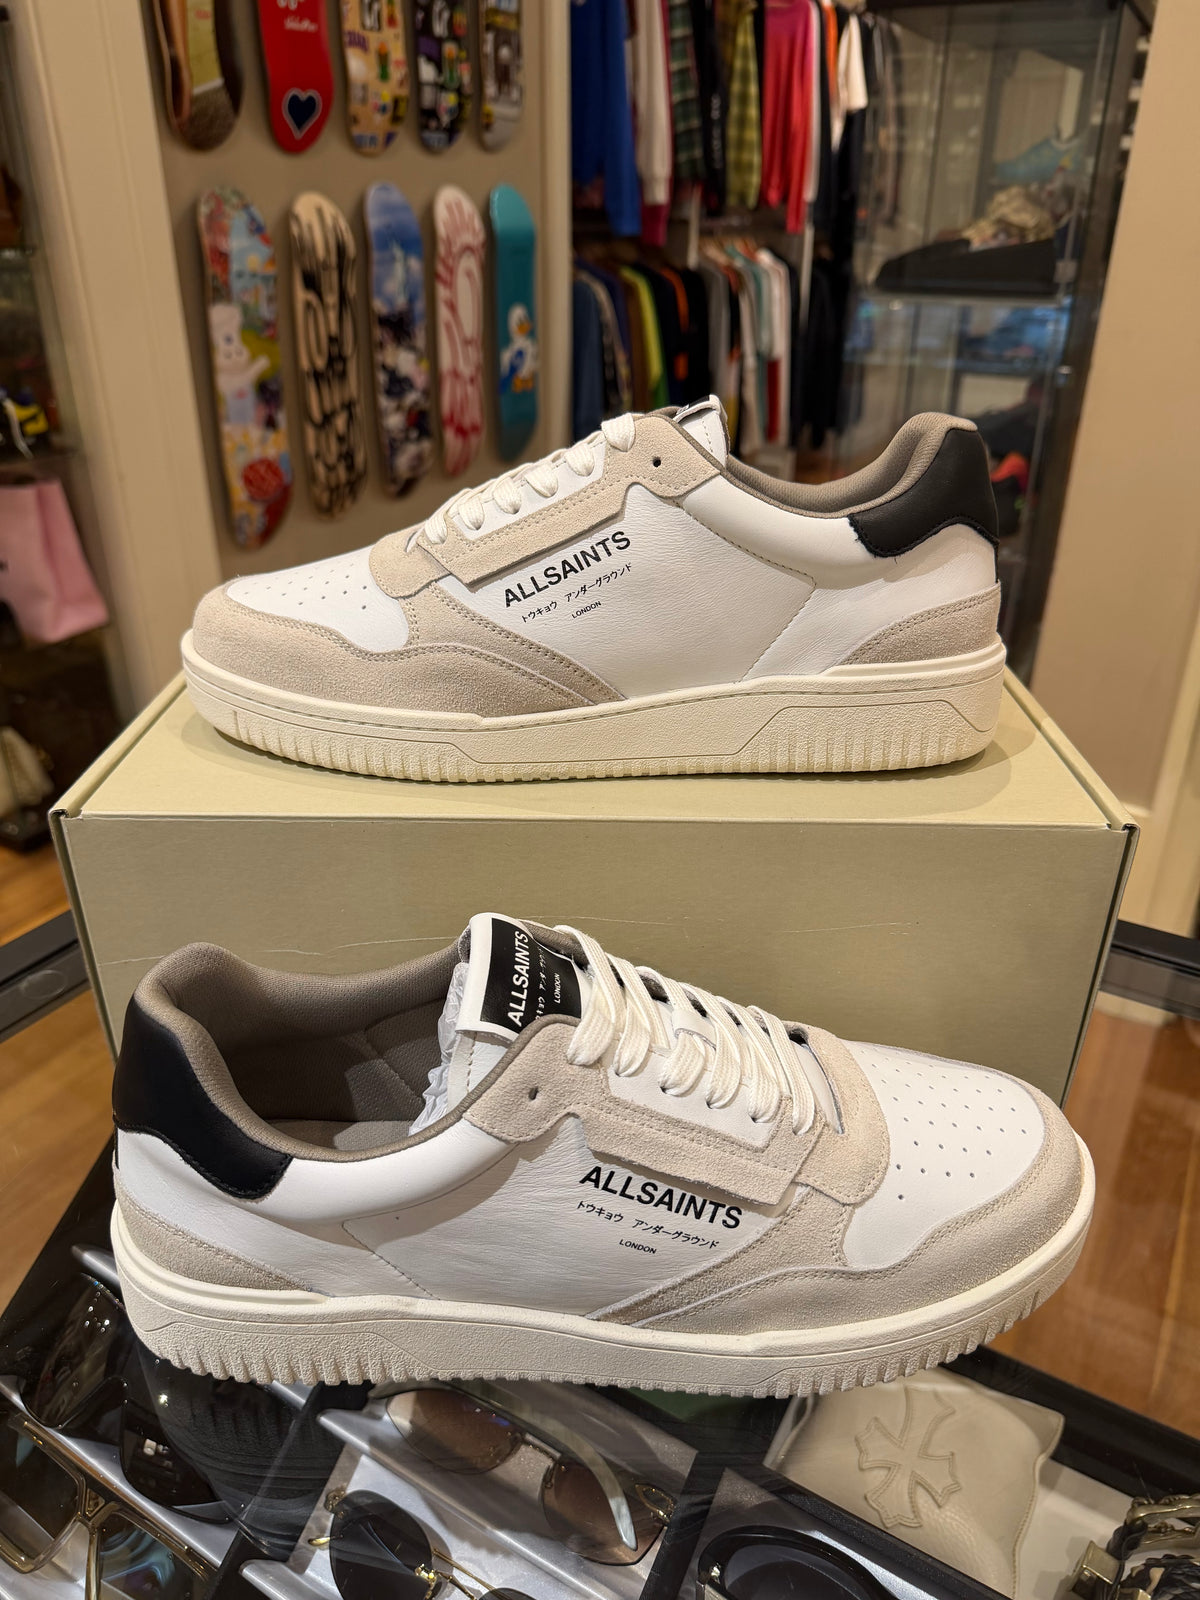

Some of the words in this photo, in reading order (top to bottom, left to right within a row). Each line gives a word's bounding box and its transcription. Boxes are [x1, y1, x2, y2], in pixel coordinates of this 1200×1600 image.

[504, 531, 631, 608] ALLSAINTS
[522, 600, 558, 623] トウキョウ
[564, 562, 632, 602] アンダーグラウンド
[571, 600, 602, 619] LONDON
[507, 931, 530, 1027] ALLSAINTS
[553, 972, 561, 1004] LONDON
[576, 1200, 624, 1223] トウキョウ
[631, 1219, 720, 1249] アンダーグラウンド
[579, 1166, 743, 1229] ALLSAINTS
[619, 1239, 657, 1255] LONDON
